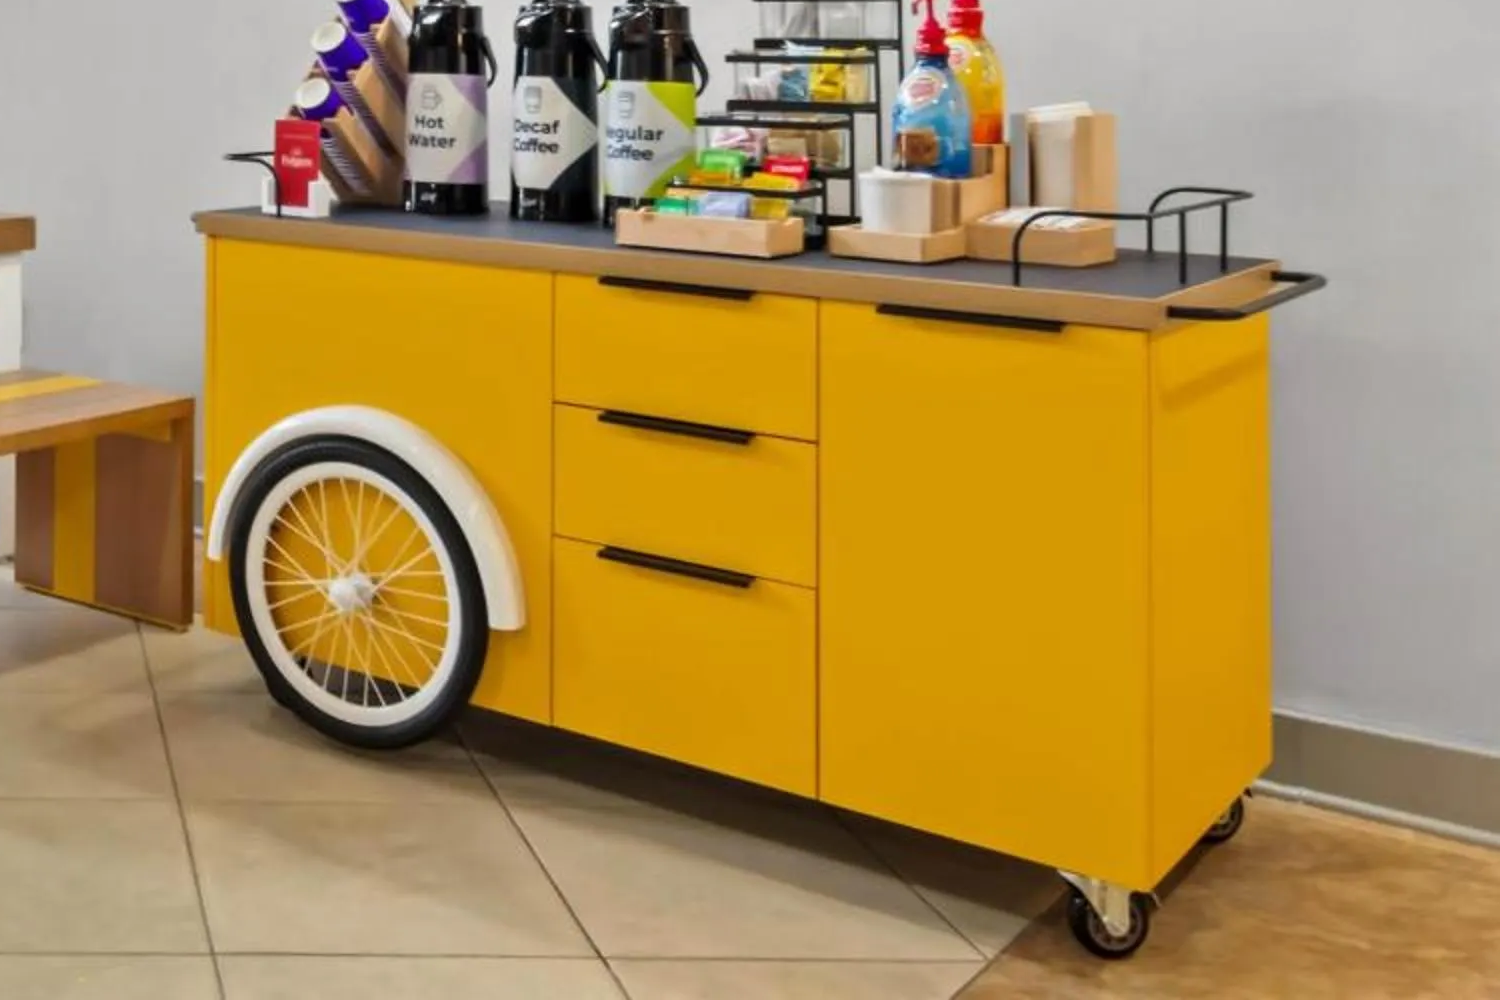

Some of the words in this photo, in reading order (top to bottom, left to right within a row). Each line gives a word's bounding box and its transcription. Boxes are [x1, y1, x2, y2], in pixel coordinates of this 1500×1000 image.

[414, 115, 444, 129] Hot
[514, 119, 560, 134] Decaf
[408, 134, 456, 149] Water
[513, 137, 560, 154] Coffee
[606, 144, 654, 161] Coffee
